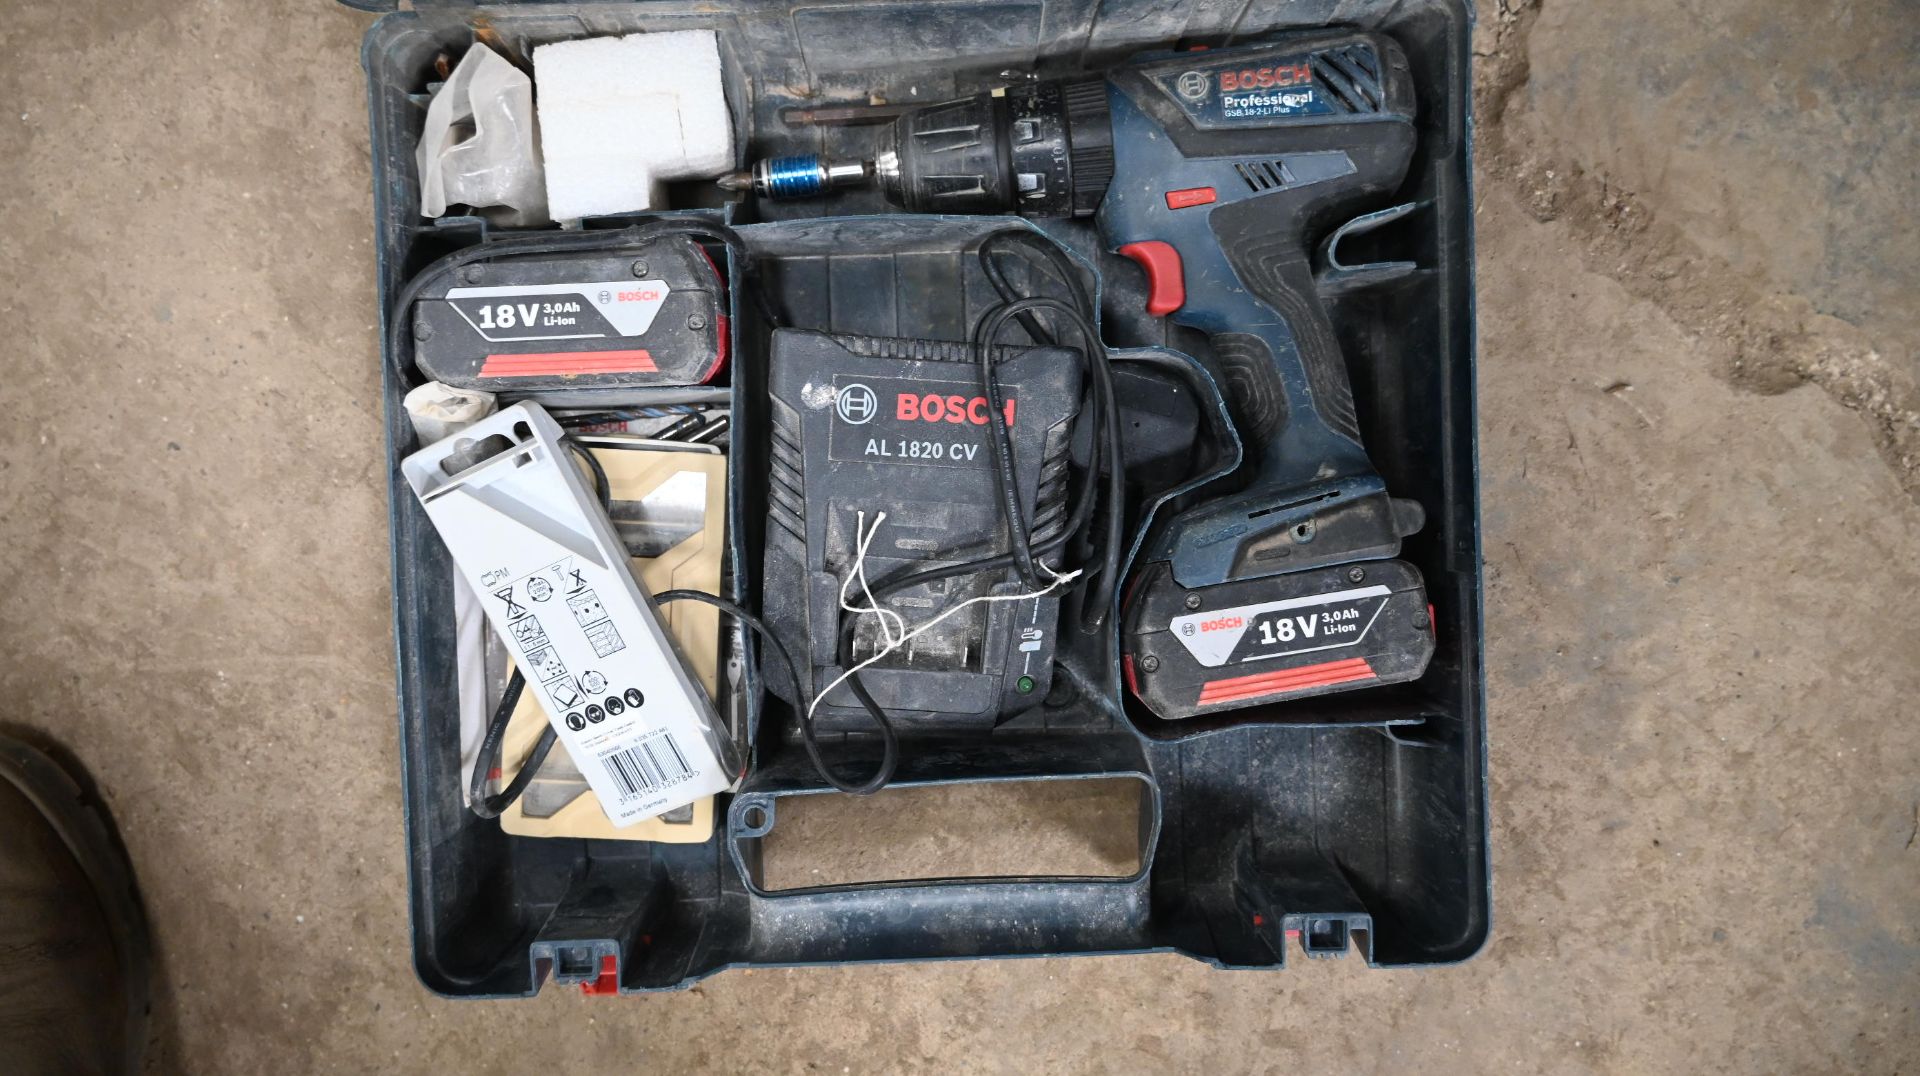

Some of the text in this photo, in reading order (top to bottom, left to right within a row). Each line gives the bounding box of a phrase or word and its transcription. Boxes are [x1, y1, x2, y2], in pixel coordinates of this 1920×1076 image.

[1220, 63, 1312, 91] BOSCH
[1225, 109, 1242, 117] GSB
[1273, 106, 1290, 114] Plus
[617, 290, 659, 302] BOSCH
[479, 303, 540, 329] 18V
[543, 315, 576, 326] Li-Ion
[864, 438, 979, 460] AL 1820 CV
[1201, 616, 1242, 632] BOSCH
[1258, 613, 1318, 645] 18V
[1323, 622, 1357, 635] Li-Ion
